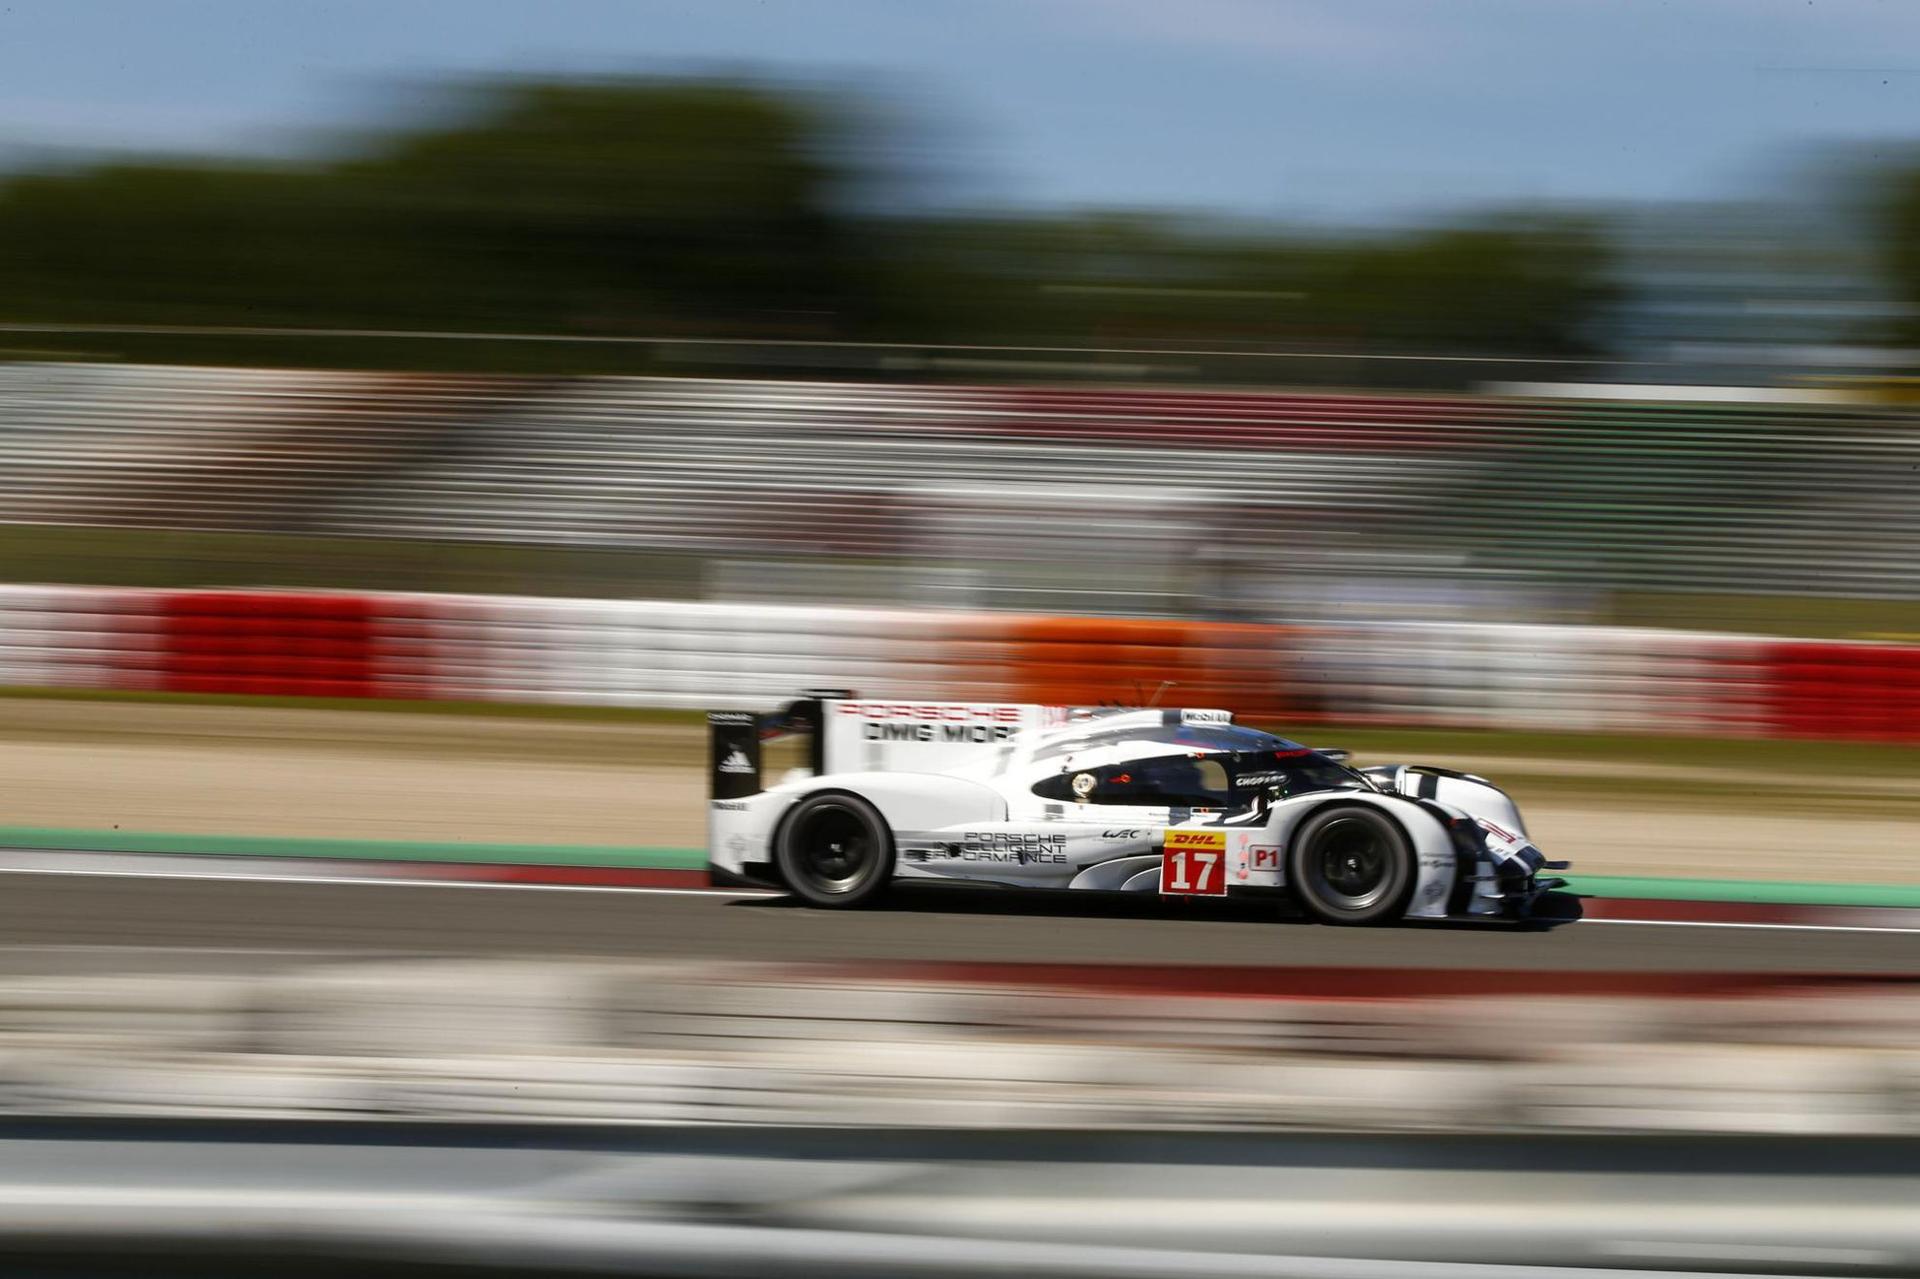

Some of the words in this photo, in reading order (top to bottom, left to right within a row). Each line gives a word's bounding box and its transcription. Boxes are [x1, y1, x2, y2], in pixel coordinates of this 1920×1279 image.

[838, 704, 1023, 722] PORSCHE
[964, 832, 1067, 844] PORSCHE
[1102, 829, 1141, 839] WEC
[1173, 834, 1217, 845] DHL
[1256, 850, 1279, 867] P1
[1170, 852, 1219, 891] 17
